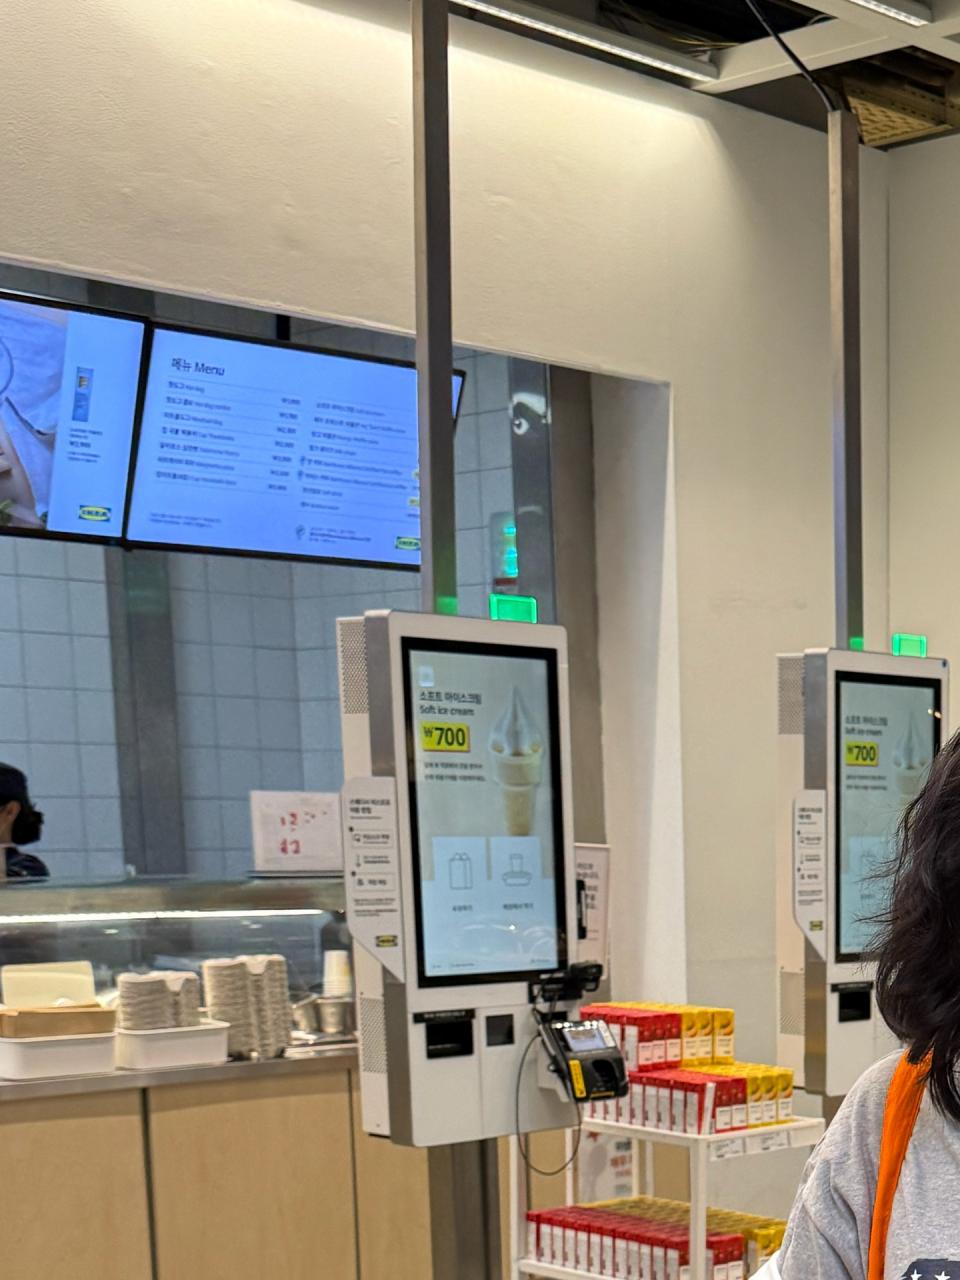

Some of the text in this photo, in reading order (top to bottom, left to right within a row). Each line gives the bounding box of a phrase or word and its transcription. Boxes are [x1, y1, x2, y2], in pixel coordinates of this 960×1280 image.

[171, 358, 225, 376] 메뉴 Menu
[420, 691, 482, 705] 소프트 아이스크림
[419, 705, 475, 716] Soft ice cream
[423, 726, 467, 747] ₩700
